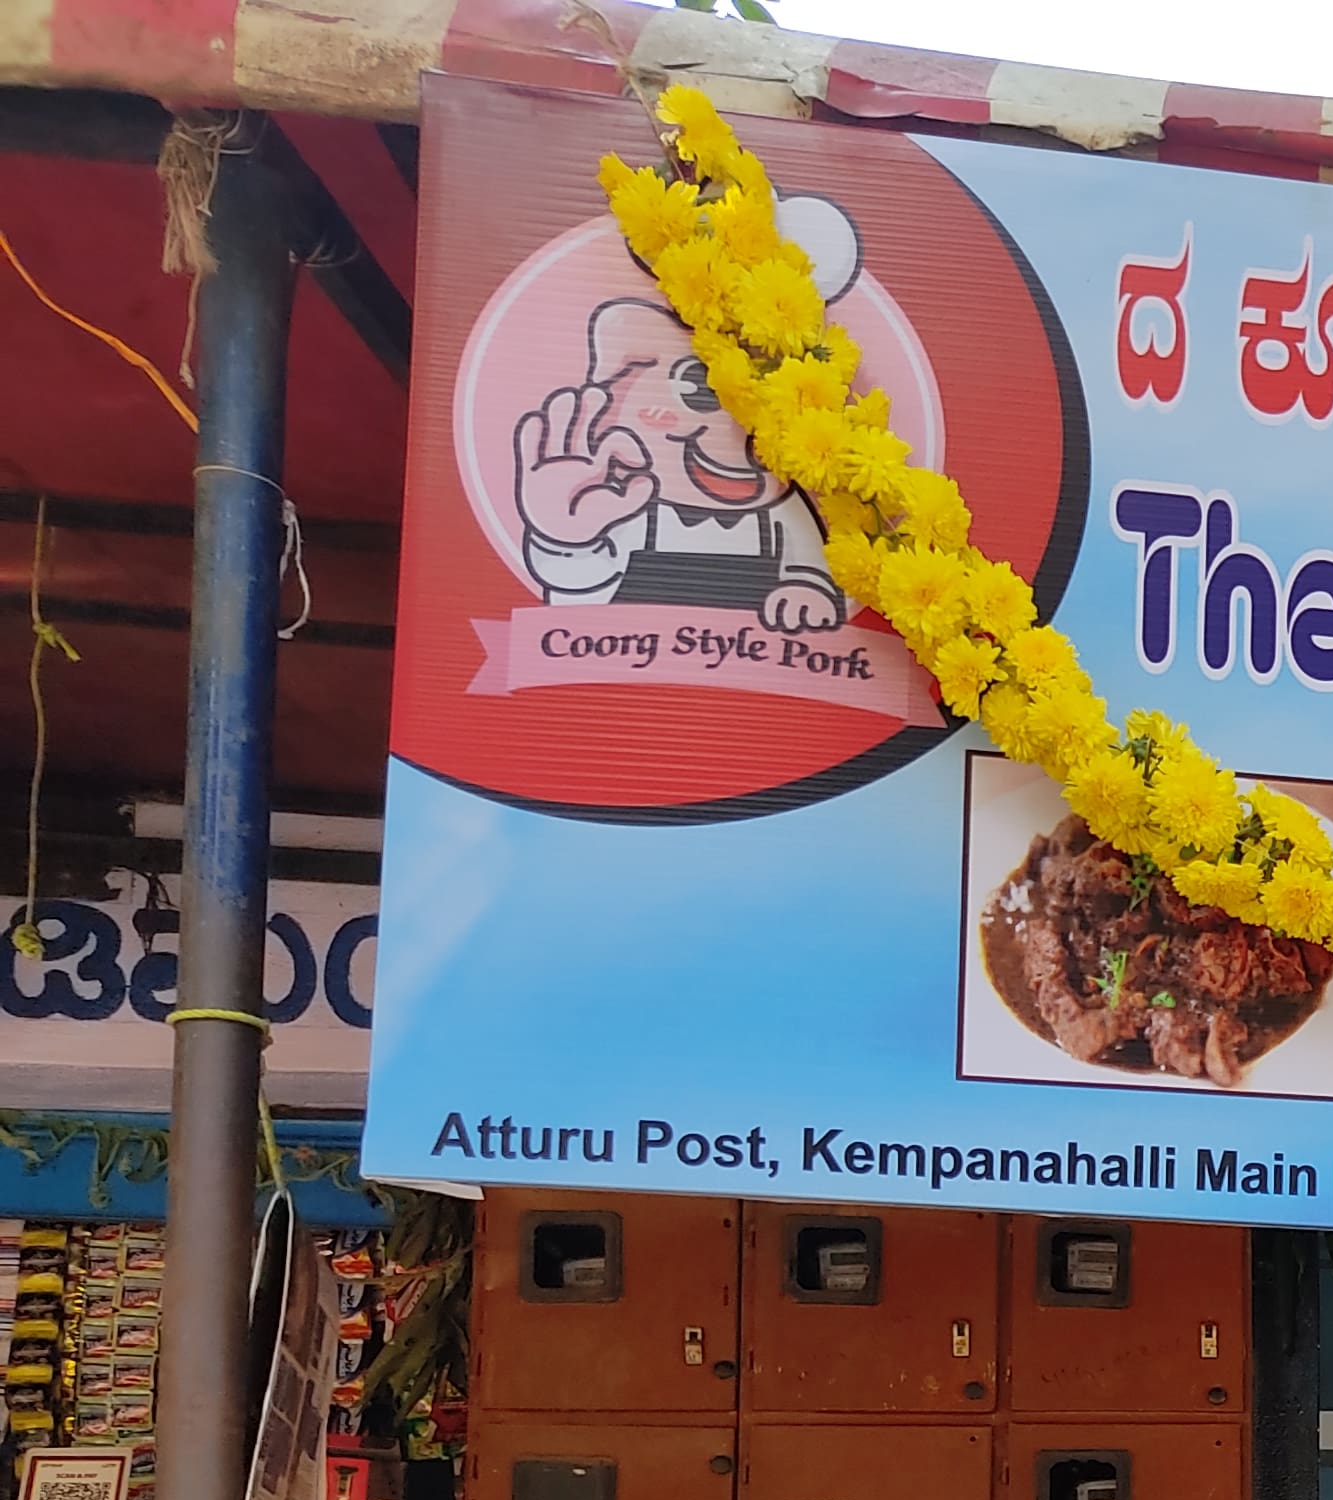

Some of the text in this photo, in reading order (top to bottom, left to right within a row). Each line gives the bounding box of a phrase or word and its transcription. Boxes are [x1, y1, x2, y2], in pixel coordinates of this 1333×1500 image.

[540, 624, 875, 681] Coorg Style Pork
[431, 1111, 615, 1164] Atturu
[636, 1118, 780, 1178] Post,
[802, 1127, 1177, 1191] Kempanahalli
[1196, 1148, 1318, 1198] Main
